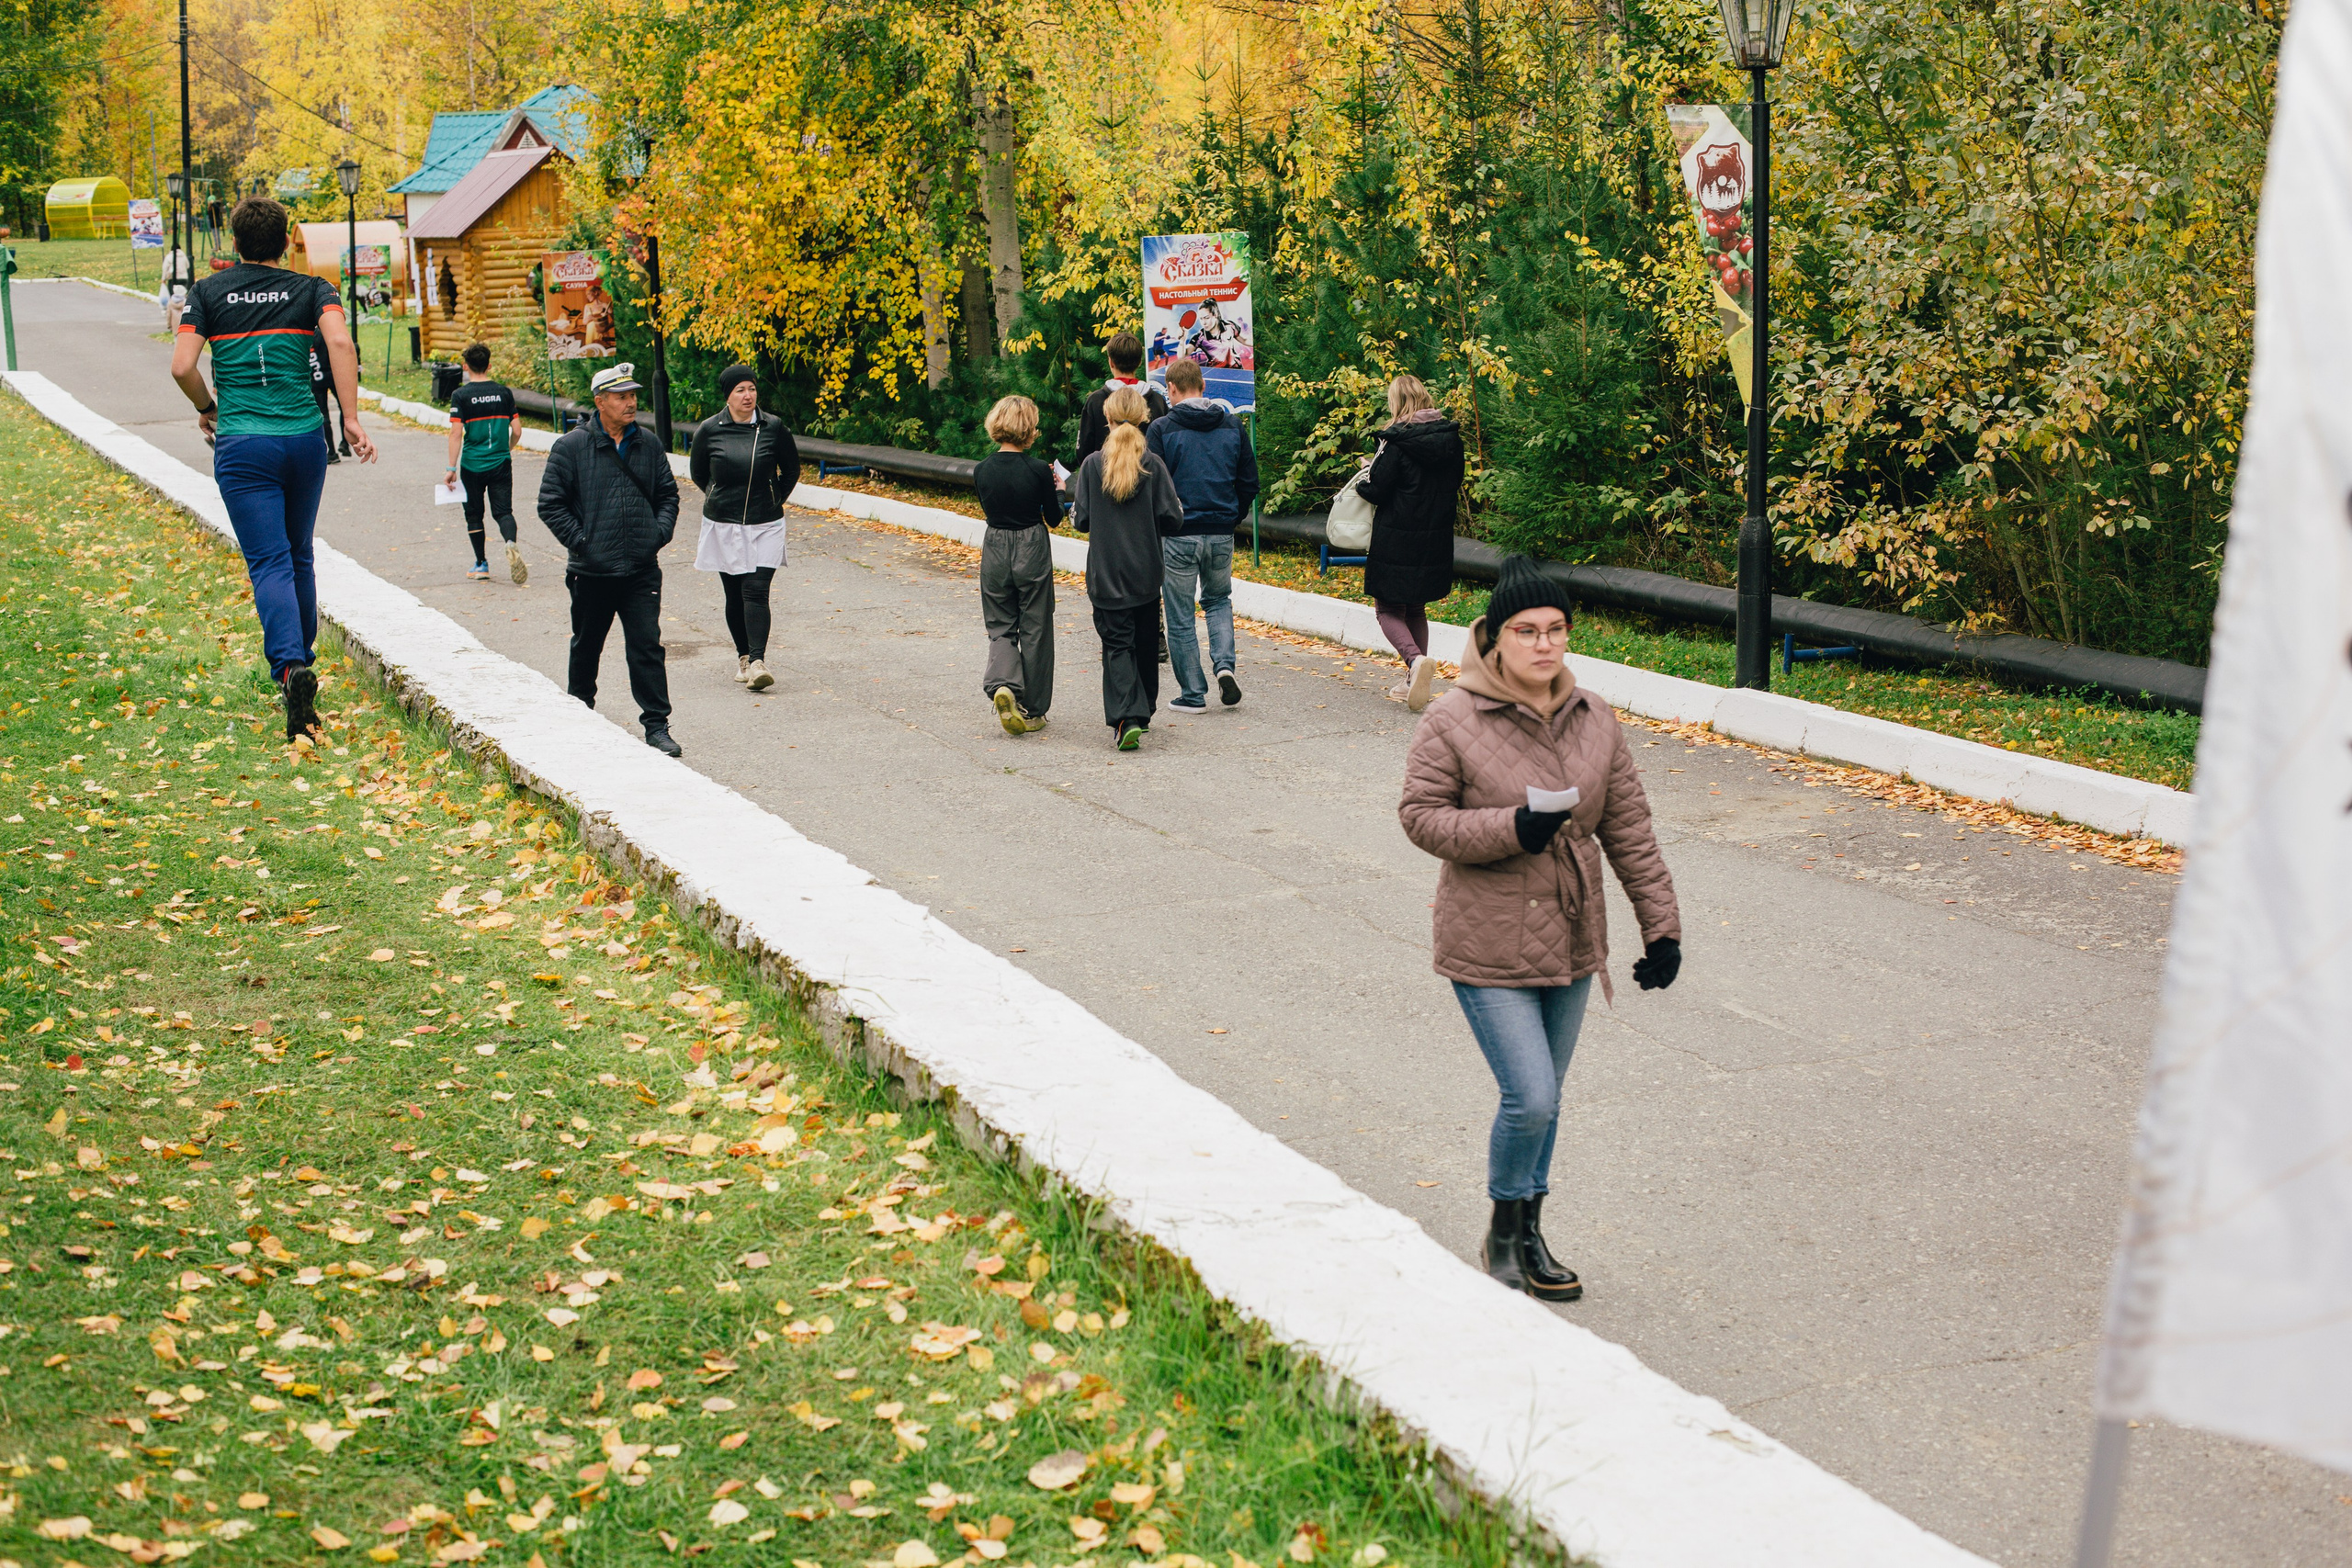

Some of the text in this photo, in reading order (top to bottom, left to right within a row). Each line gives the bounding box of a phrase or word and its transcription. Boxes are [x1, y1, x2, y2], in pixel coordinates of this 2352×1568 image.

[565, 281, 588, 289] САУНА
[227, 291, 289, 304] O-UGRA
[1159, 287, 1238, 299] НАСТОЛЬНЫЙ ТЕННИС
[471, 395, 502, 404] O-UGRA
